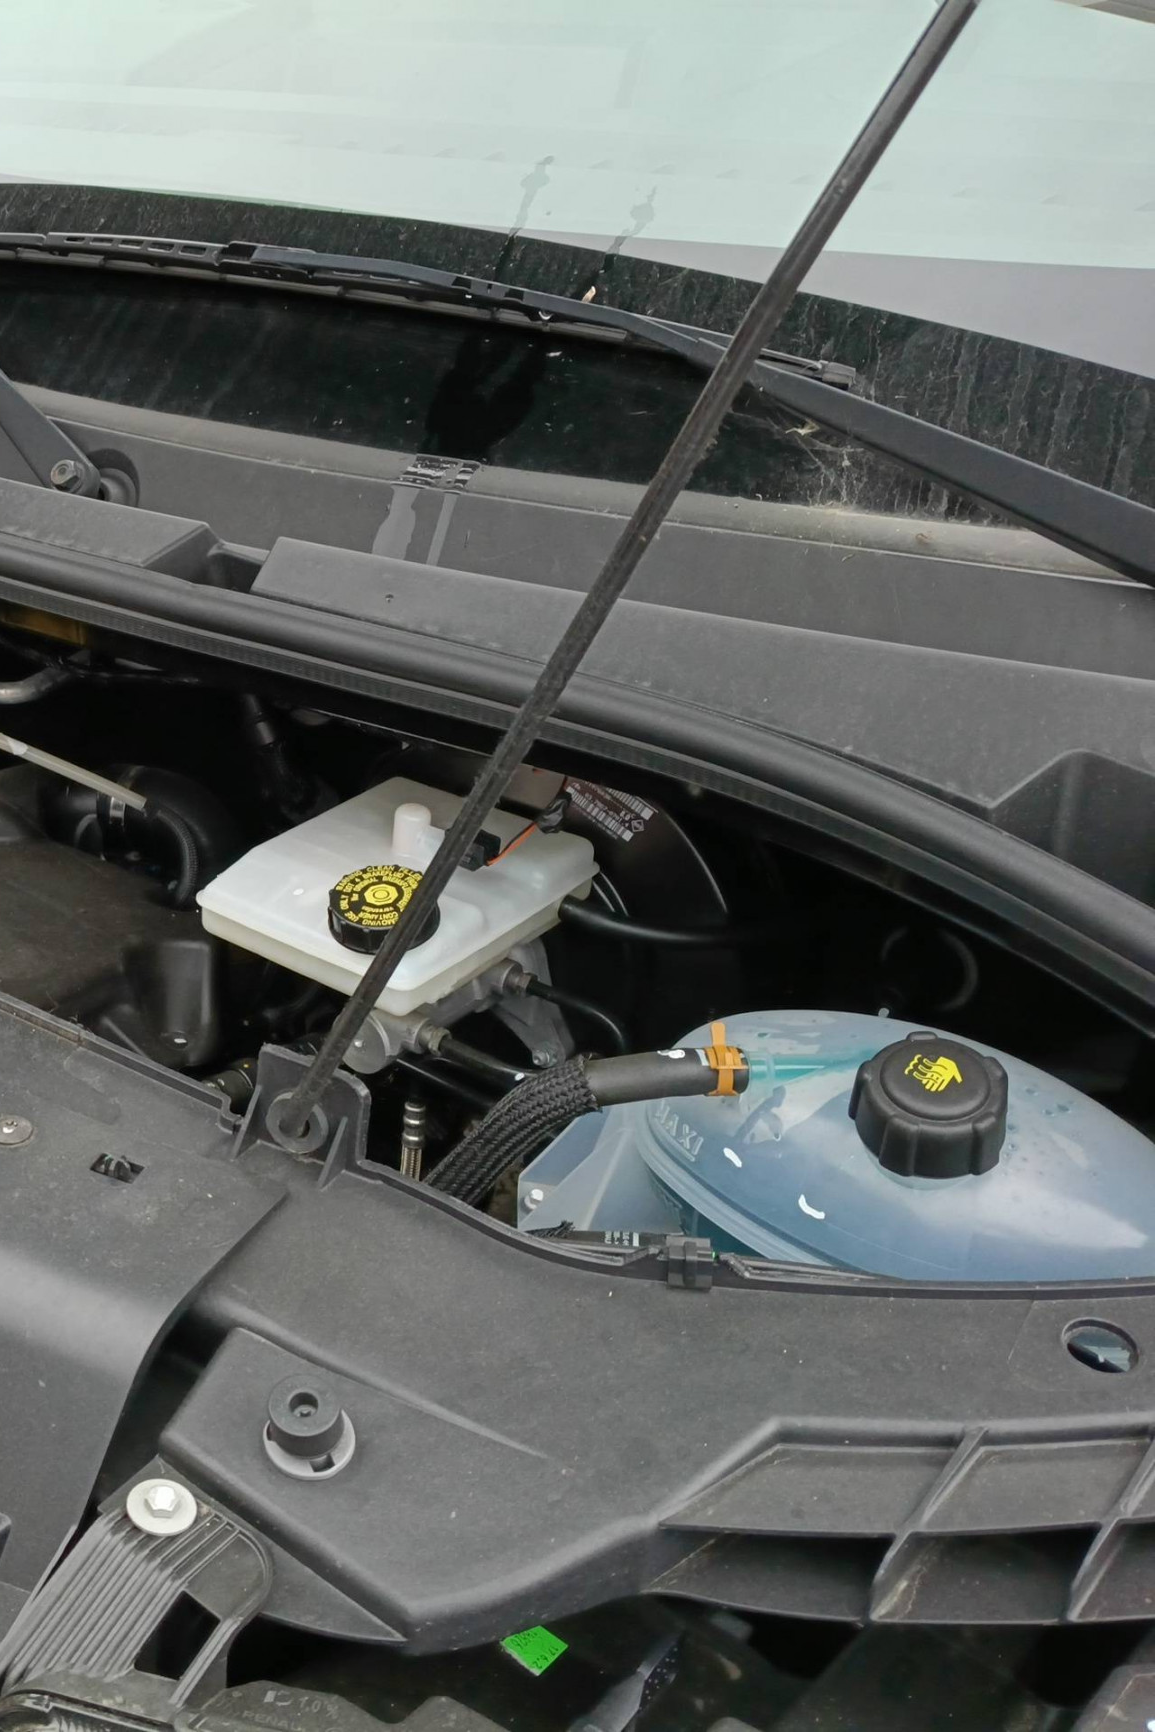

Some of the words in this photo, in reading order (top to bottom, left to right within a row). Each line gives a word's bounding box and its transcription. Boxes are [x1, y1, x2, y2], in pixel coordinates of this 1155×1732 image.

[366, 865, 395, 873] CLEAN
[339, 894, 350, 910] ONLY
[344, 910, 360, 923] USE
[358, 911, 399, 921] CONTAINER
[241, 1709, 306, 1732] RENAU
